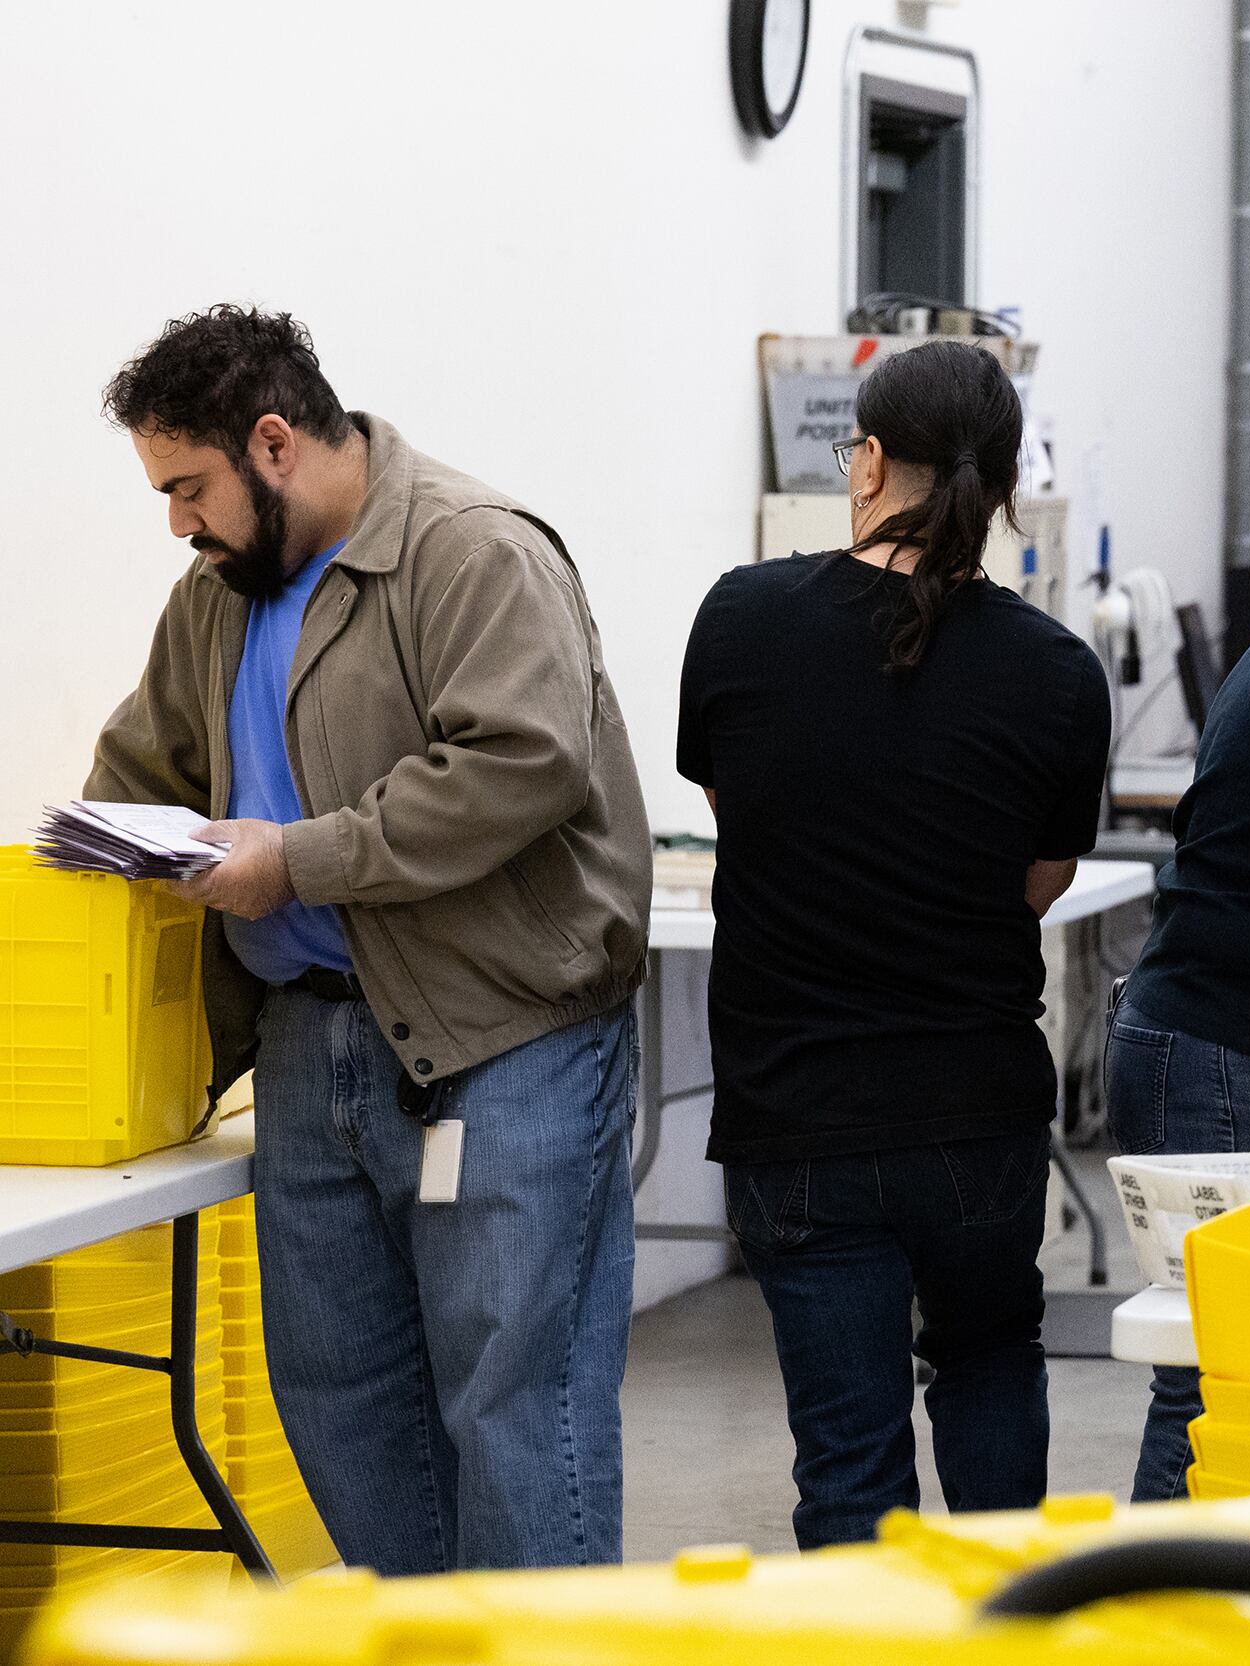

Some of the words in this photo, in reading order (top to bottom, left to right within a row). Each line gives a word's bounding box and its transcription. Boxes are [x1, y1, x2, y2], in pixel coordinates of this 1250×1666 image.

[804, 398, 857, 416] UNIT
[795, 423, 853, 441] POST
[1189, 1186, 1225, 1202] LABEL
